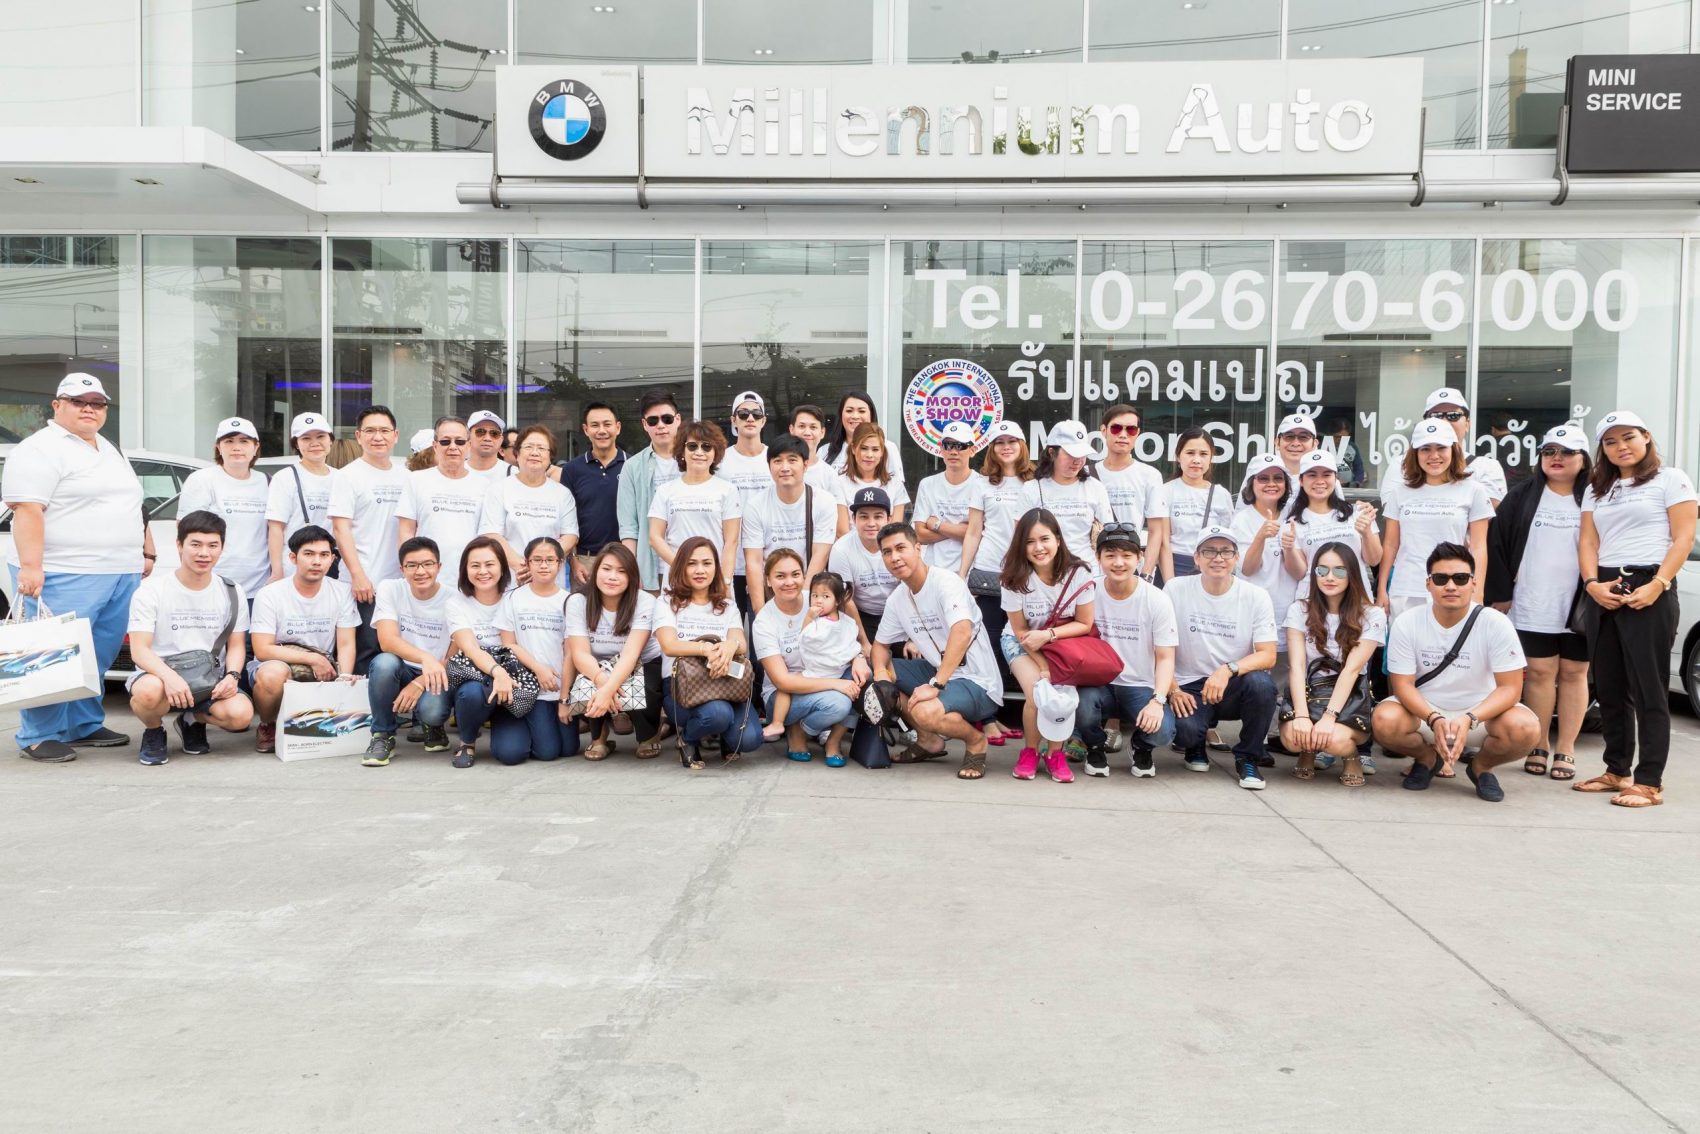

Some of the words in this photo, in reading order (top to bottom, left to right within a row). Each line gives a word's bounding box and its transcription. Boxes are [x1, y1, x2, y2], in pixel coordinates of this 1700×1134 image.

[1588, 69, 1637, 87] MINI
[536, 82, 600, 108] BMW
[1586, 92, 1682, 112] SERVICE
[687, 86, 1140, 156] Millennium
[1166, 83, 1374, 153] Auto
[915, 268, 1043, 330] Tel.
[906, 388, 917, 405] THE
[913, 361, 950, 388] BANGKOK
[952, 360, 1001, 406] INTERNATIONAL
[926, 397, 982, 407] MOTOR
[926, 408, 982, 420] SHOW
[909, 424, 934, 451] GREATEST
